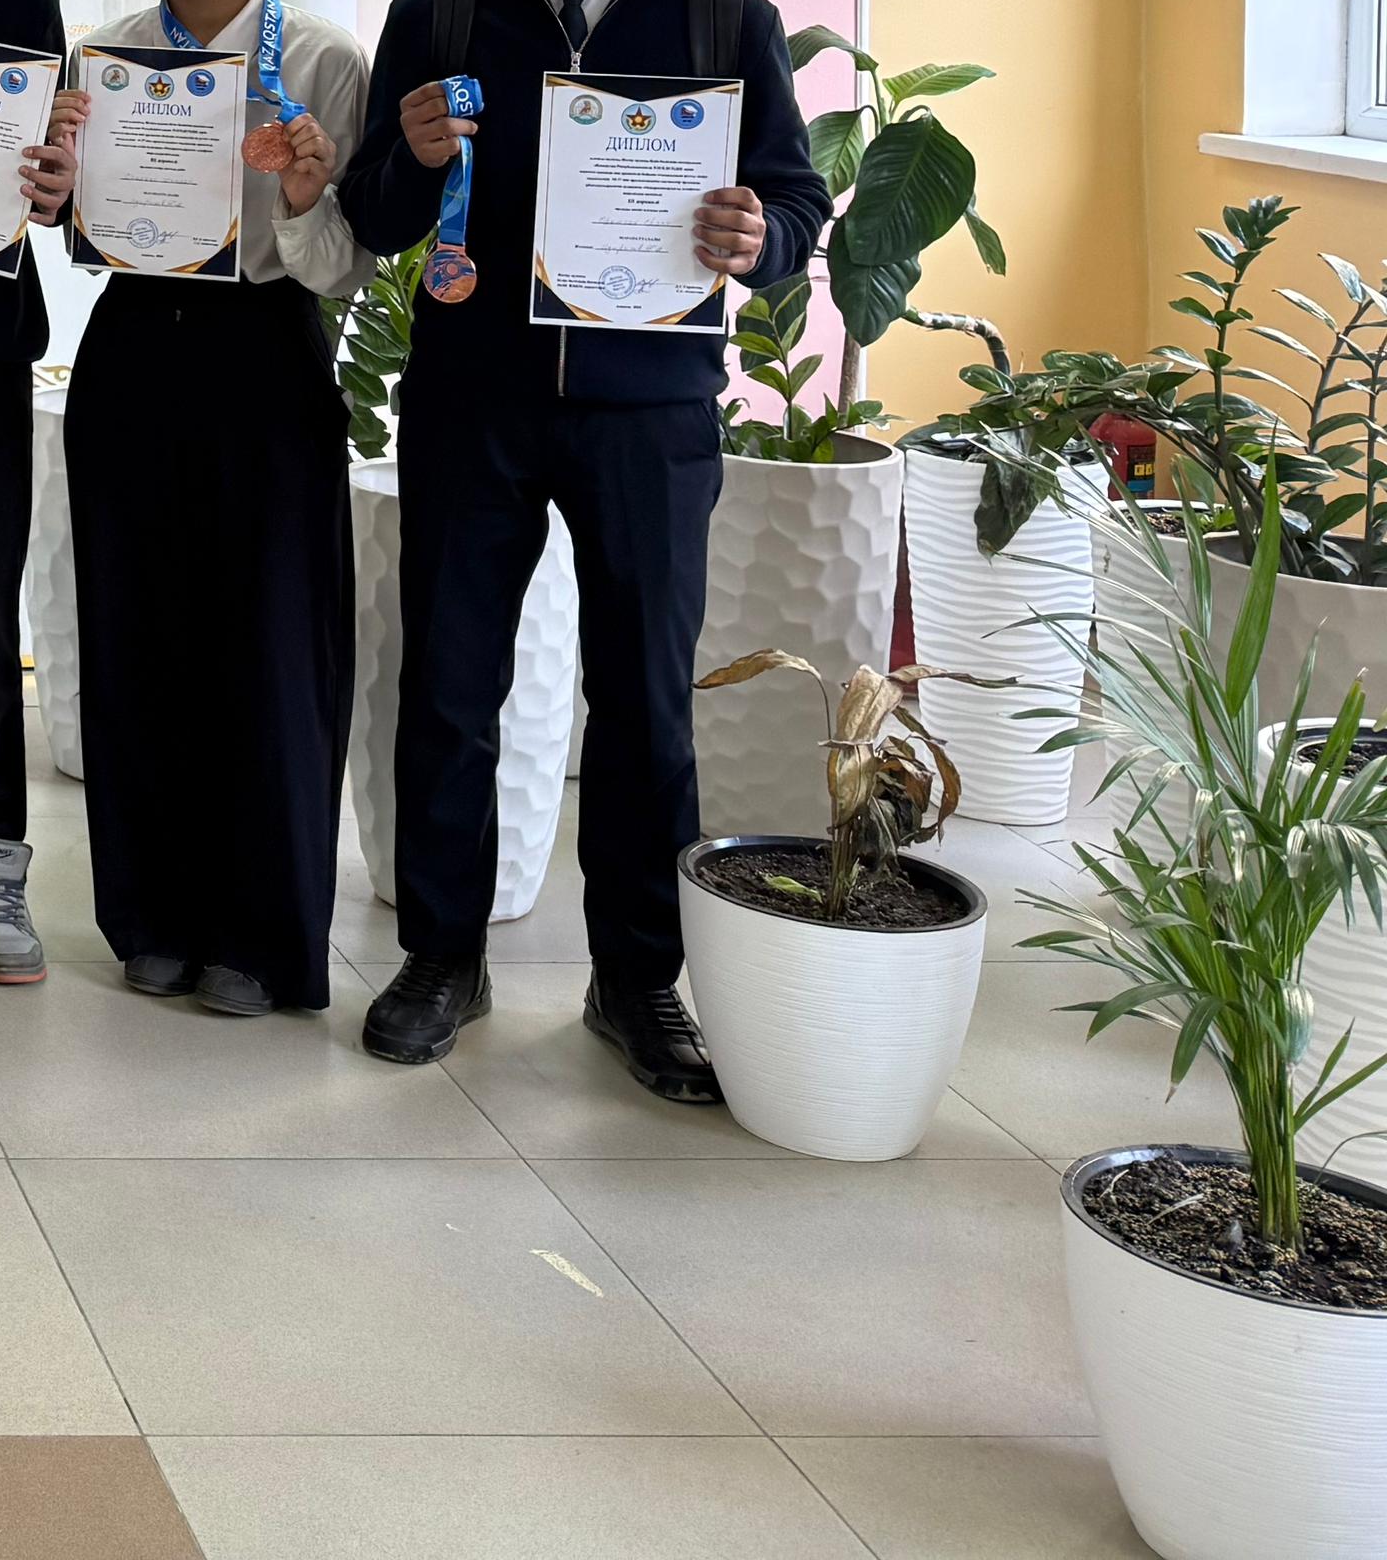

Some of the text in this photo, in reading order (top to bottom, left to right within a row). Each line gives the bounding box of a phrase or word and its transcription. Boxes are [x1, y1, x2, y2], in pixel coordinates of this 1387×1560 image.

[261, 0, 278, 72] QAZAQSTAN
[132, 101, 192, 117] ДИПЛОМ
[605, 137, 677, 153] ДИПЛОМ
